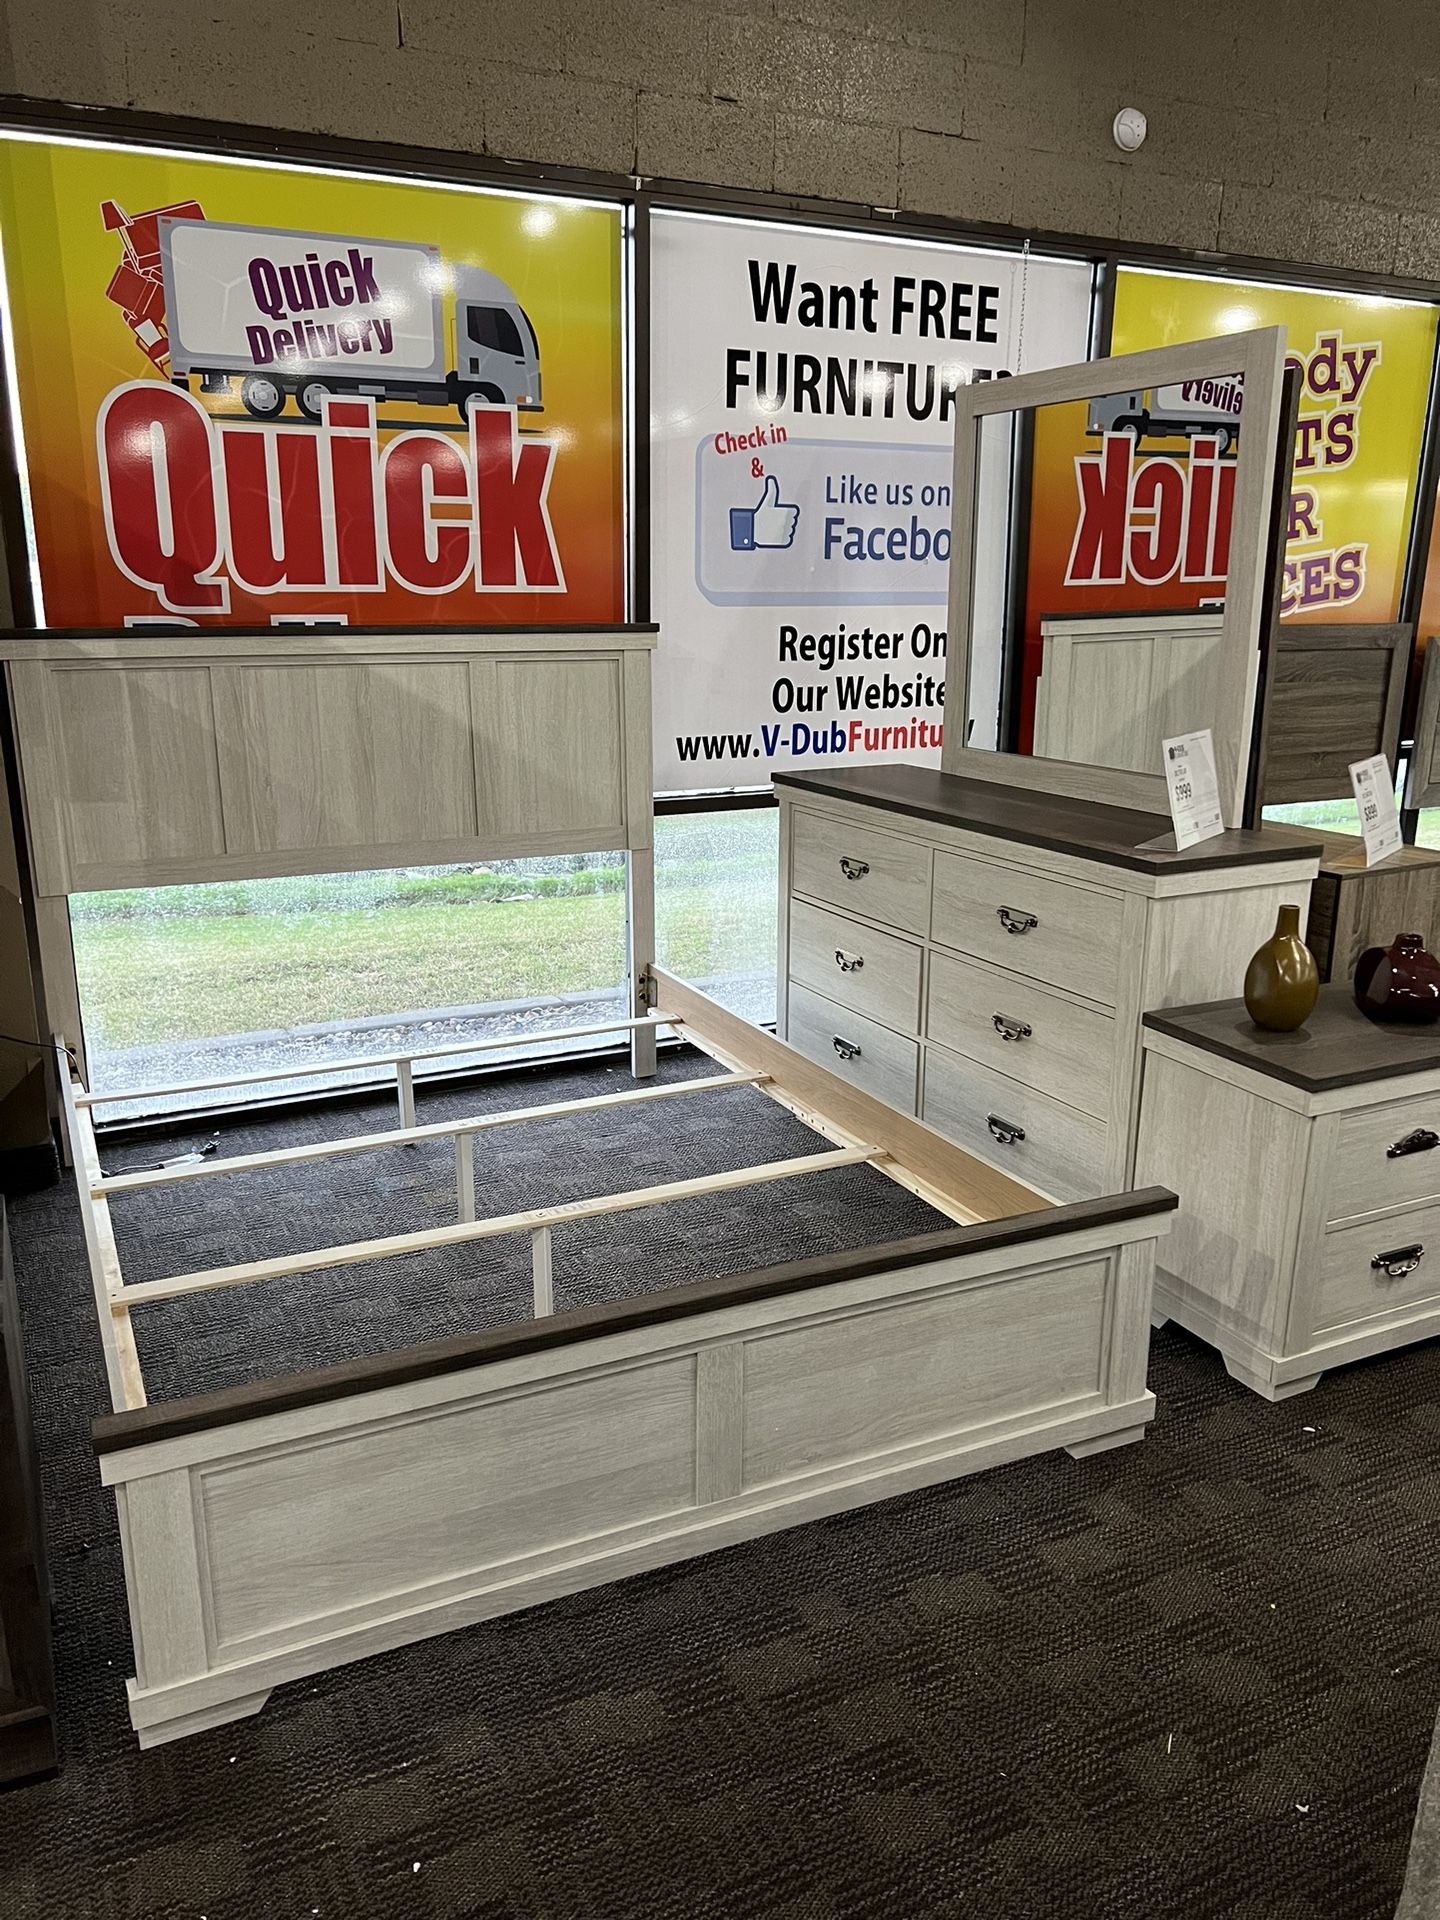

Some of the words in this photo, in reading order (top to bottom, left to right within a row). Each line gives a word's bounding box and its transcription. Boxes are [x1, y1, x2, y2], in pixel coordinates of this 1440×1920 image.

[248, 248, 379, 317] Quick
[747, 259, 879, 333] Want
[891, 275, 1001, 344] FREE
[246, 315, 394, 365] Delivery
[725, 348, 1013, 421] FURNITUR
[714, 425, 768, 456] Check
[770, 422, 787, 444] in
[751, 457, 765, 478] &
[825, 475, 878, 506] Like
[886, 480, 914, 506] us
[920, 485, 951, 506] on
[97, 380, 567, 613] Quick
[779, 624, 904, 671] Register
[911, 623, 947, 659] On
[772, 677, 828, 713] Our
